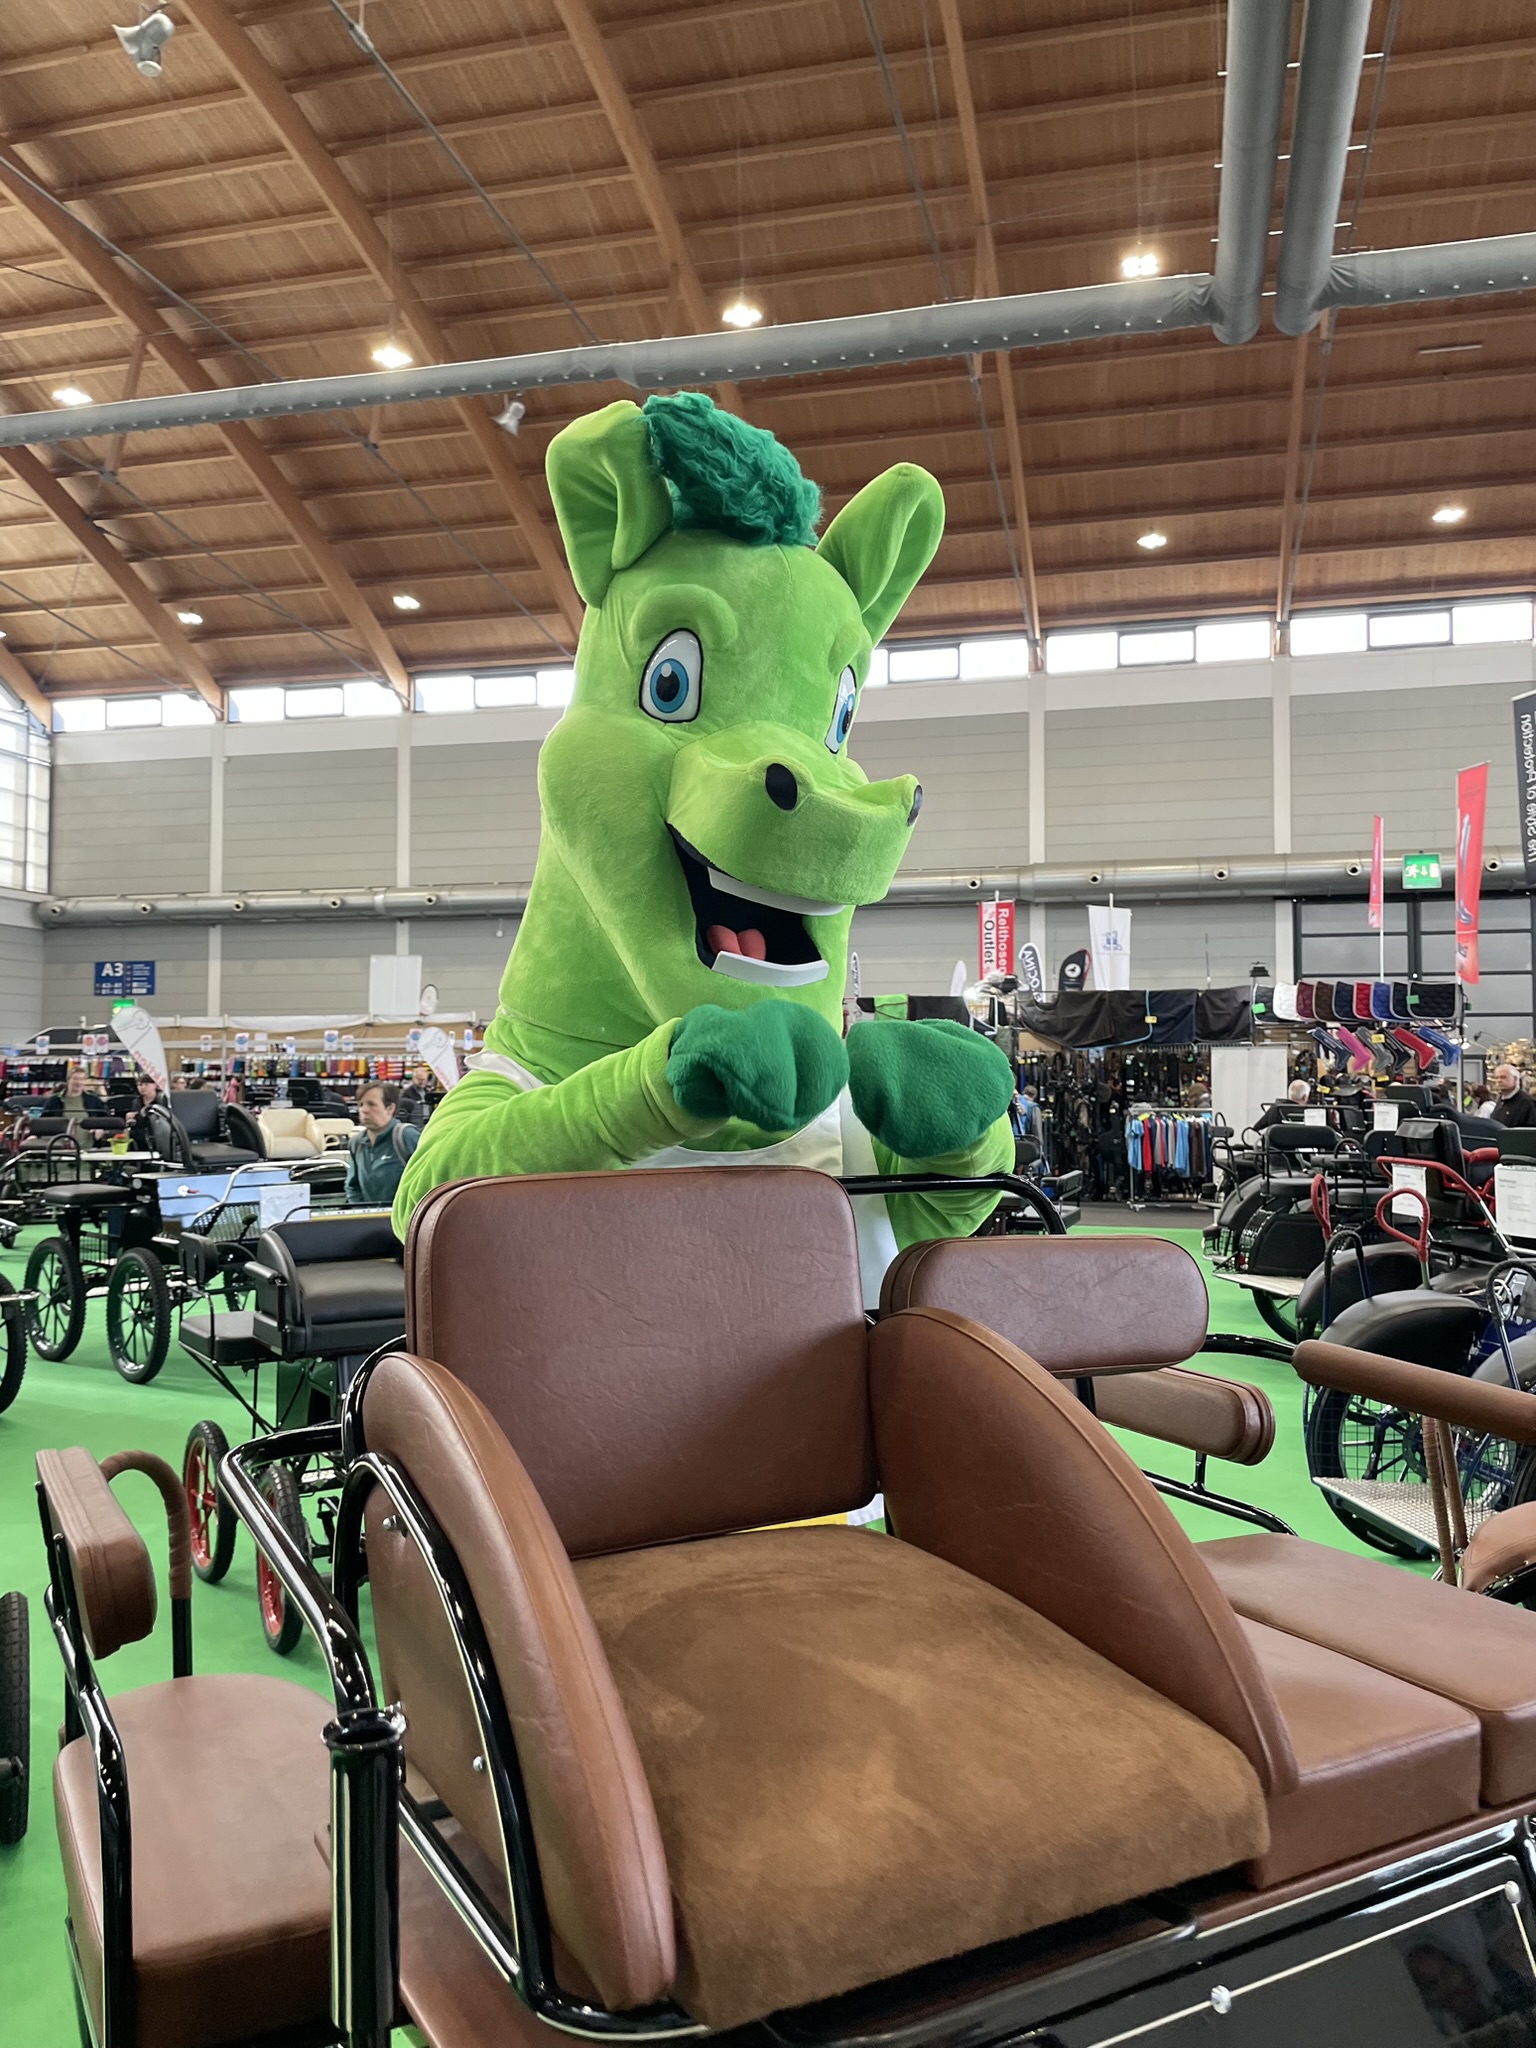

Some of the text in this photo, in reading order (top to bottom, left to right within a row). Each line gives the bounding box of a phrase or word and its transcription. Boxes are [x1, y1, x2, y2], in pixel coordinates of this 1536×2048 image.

[984, 920, 995, 964] Outlet
[998, 908, 1010, 975] Reithosen
[101, 962, 124, 977] A3
